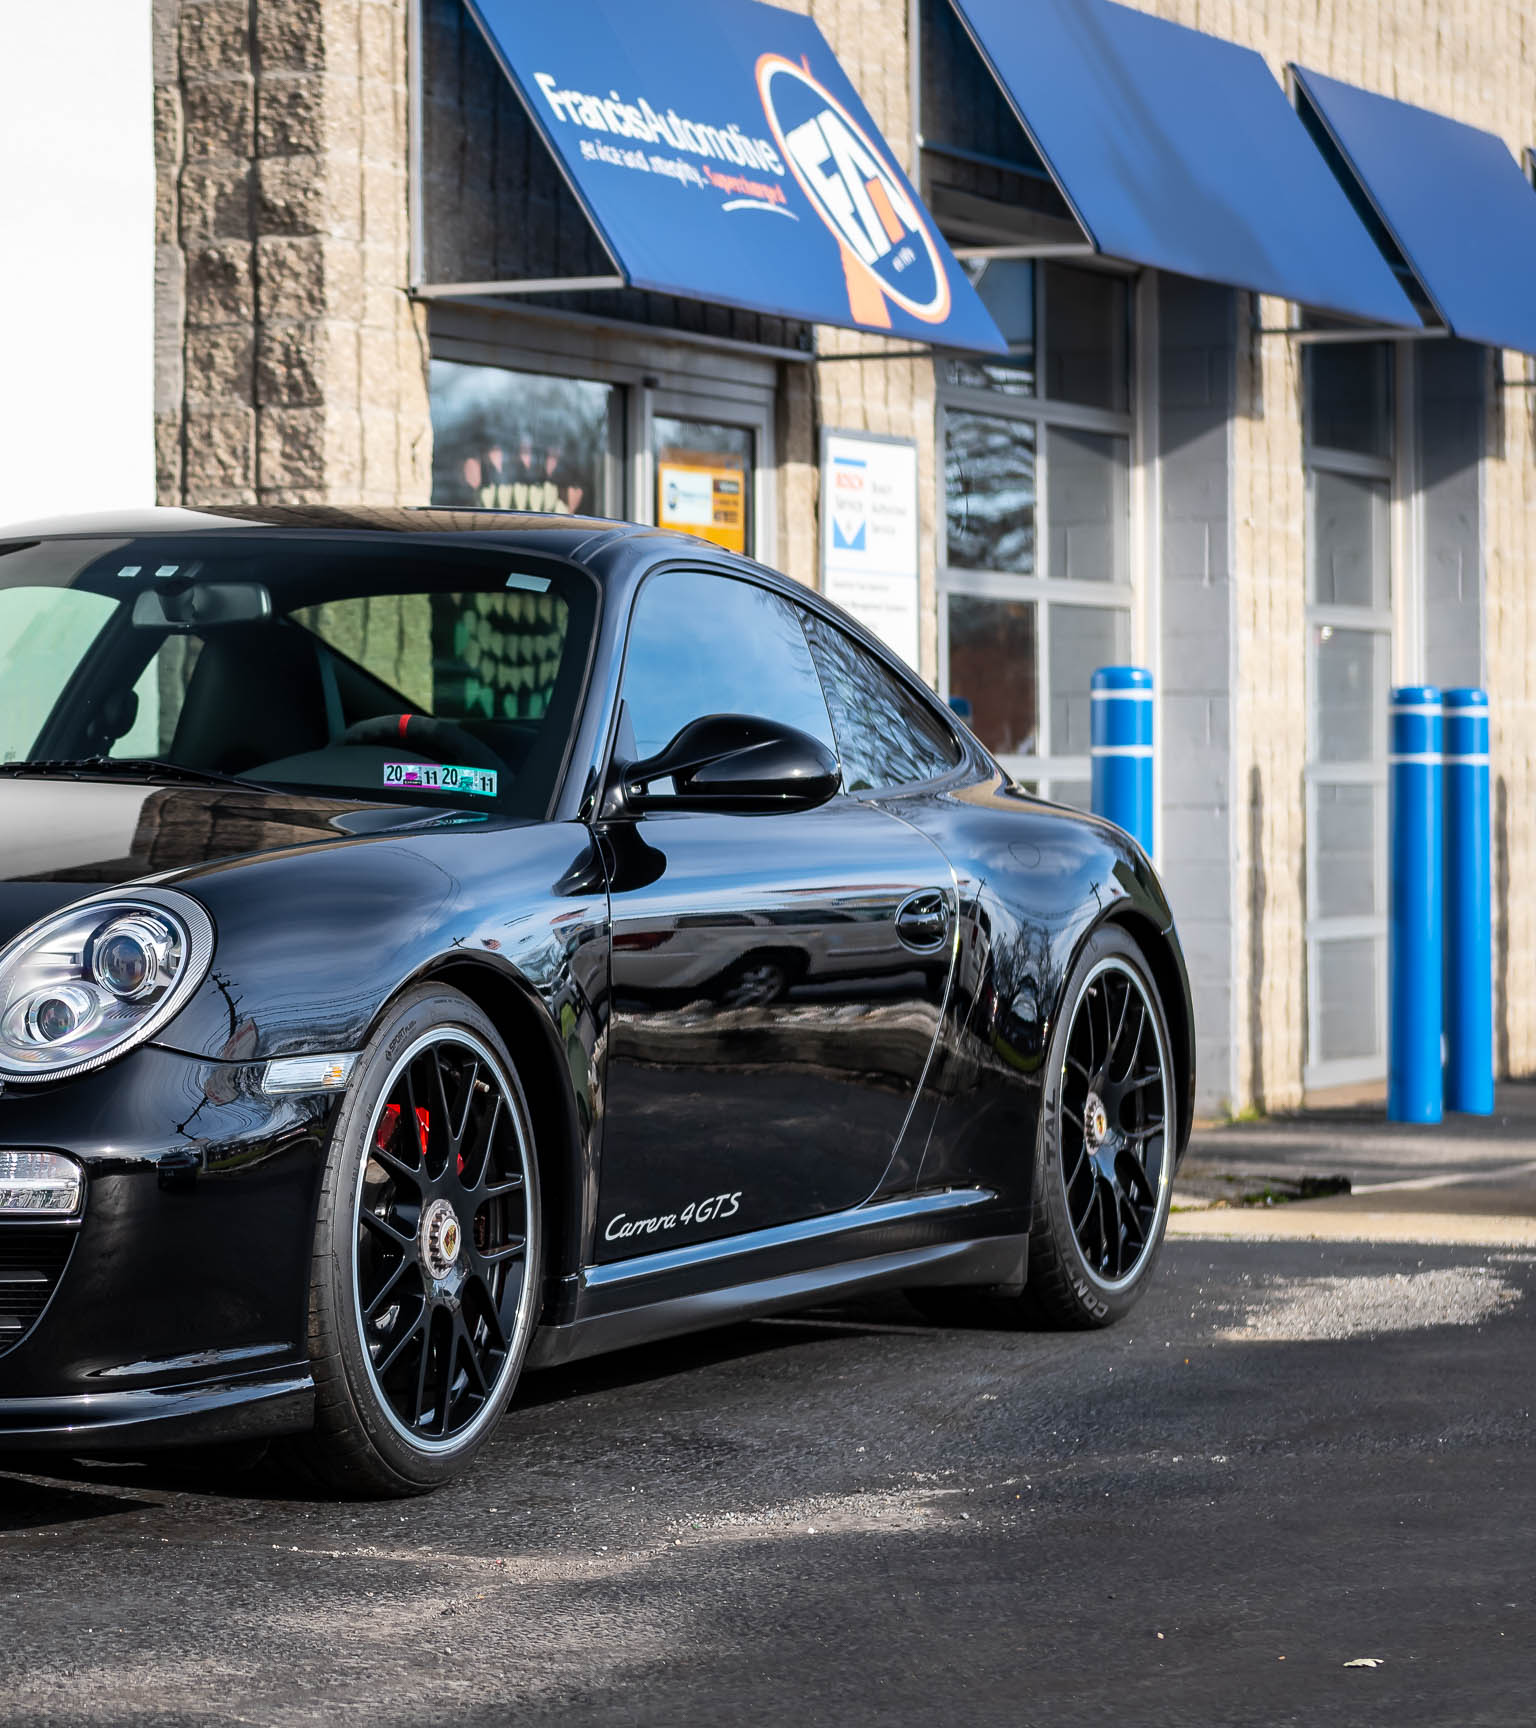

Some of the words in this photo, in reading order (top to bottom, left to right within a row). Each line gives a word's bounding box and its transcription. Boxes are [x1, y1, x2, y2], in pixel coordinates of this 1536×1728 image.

[386, 765, 403, 781] 20
[442, 768, 458, 785] 20
[605, 1213, 676, 1241] Carrera
